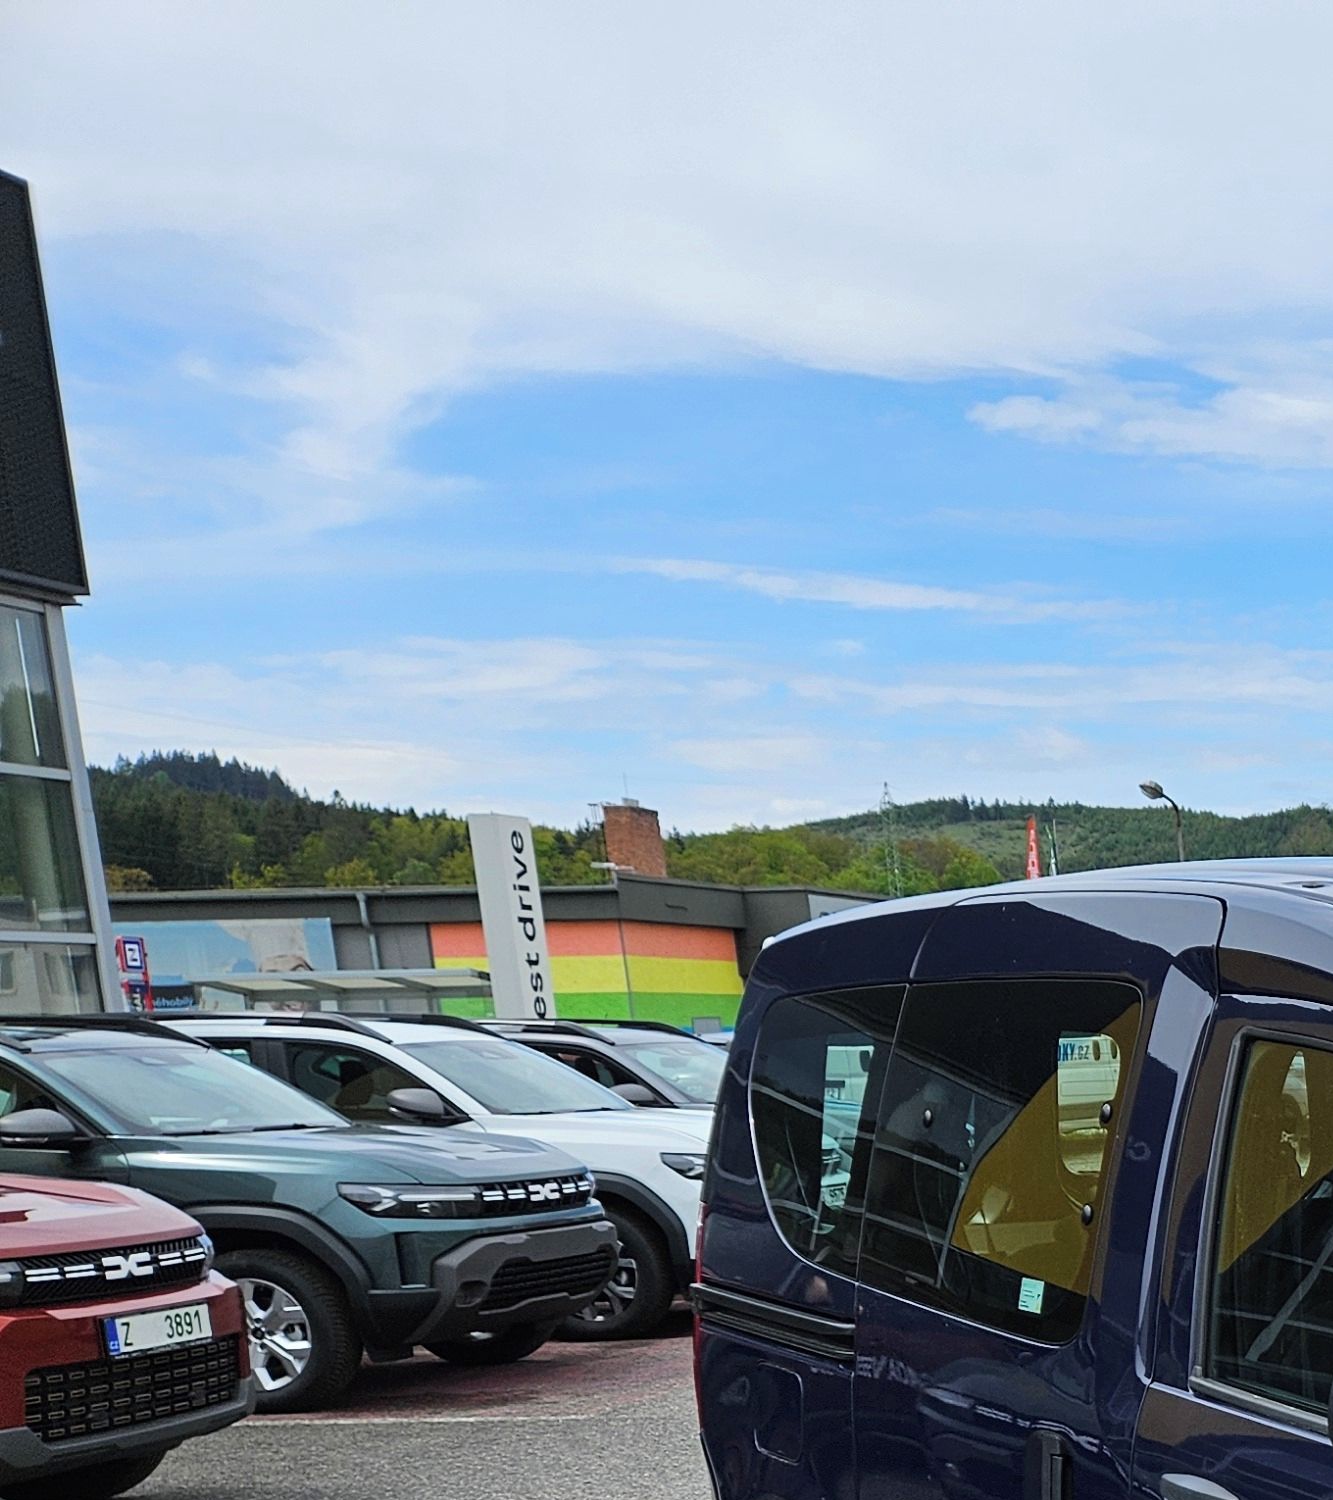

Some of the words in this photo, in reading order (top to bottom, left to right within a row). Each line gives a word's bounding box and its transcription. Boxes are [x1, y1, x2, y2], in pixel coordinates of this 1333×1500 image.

[511, 830, 537, 942] drive
[121, 1321, 133, 1347] Z
[164, 1309, 203, 1338] 3891
